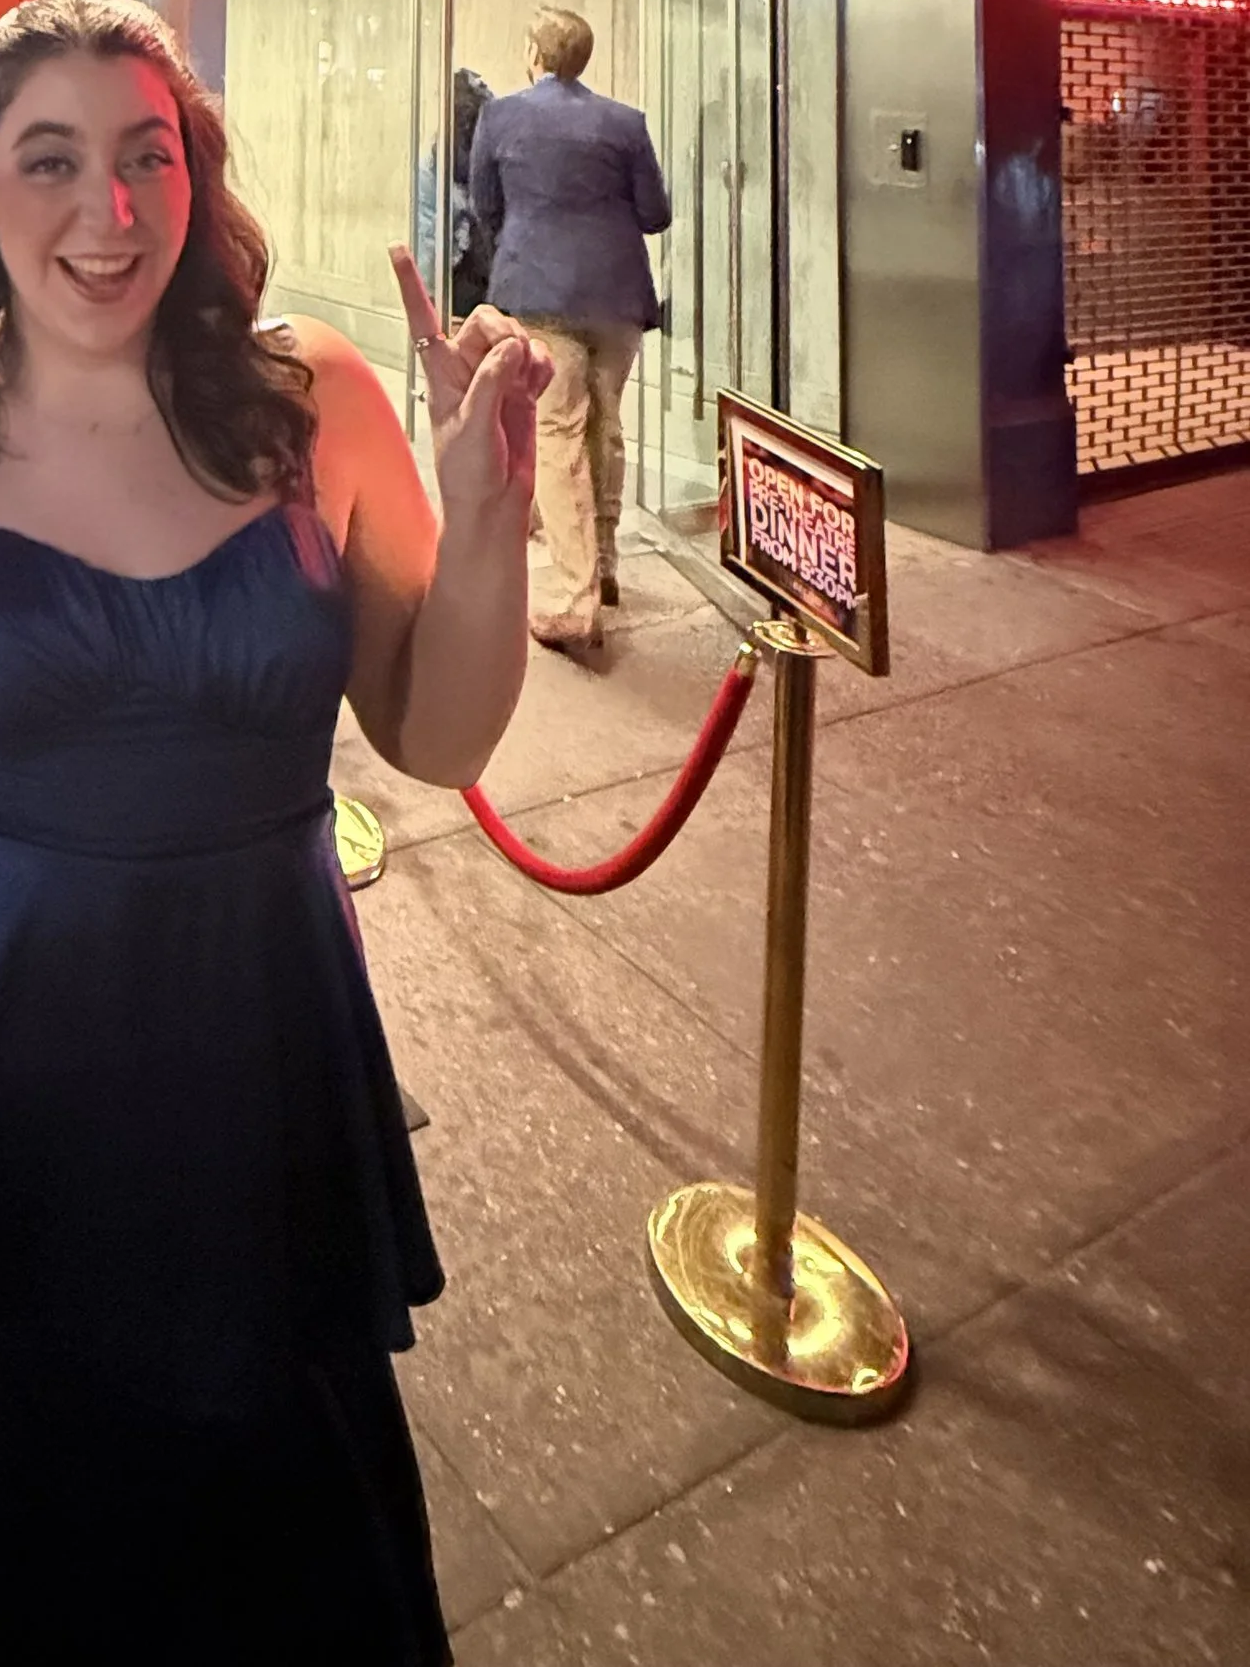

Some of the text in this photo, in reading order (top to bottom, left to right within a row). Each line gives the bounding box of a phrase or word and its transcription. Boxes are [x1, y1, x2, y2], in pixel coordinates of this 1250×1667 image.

[748, 458, 856, 535] OPEN FOR
[749, 478, 856, 559] PRE-THEATRE
[750, 498, 857, 593] DINNER
[751, 525, 797, 573] FROM
